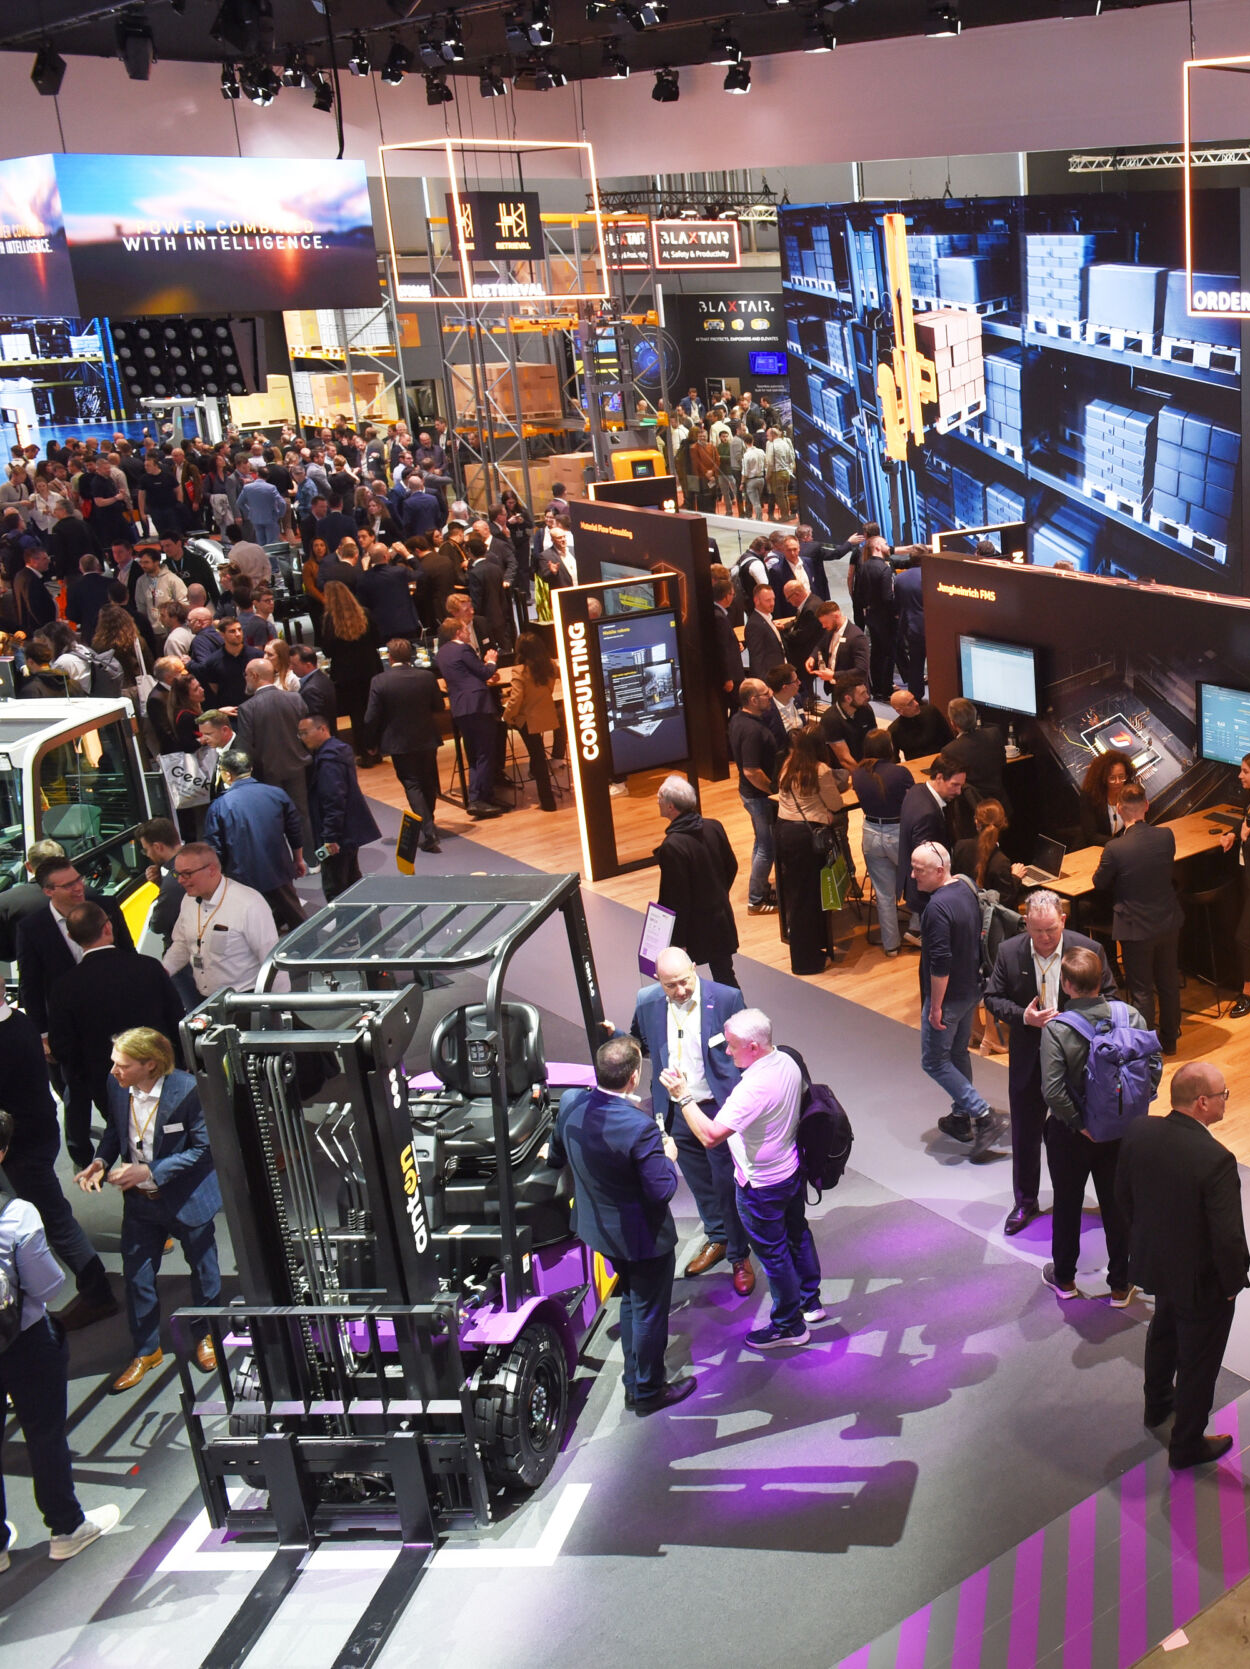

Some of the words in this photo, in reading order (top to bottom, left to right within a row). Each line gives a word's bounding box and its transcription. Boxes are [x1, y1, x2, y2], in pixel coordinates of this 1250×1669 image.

[136, 220, 207, 234] POWER
[122, 236, 177, 251] WITH
[186, 236, 330, 251] INTELLIGENCE.
[660, 231, 729, 245] BLAXTAIR
[495, 242, 531, 250] RETRIEVAL
[671, 250, 689, 259] Safety
[696, 250, 729, 259] Productivity
[472, 283, 546, 298] RETRIEVAL
[937, 582, 980, 599] Jungheinrich
[980, 589, 996, 601] FMS
[568, 622, 600, 761] CONSULTING
